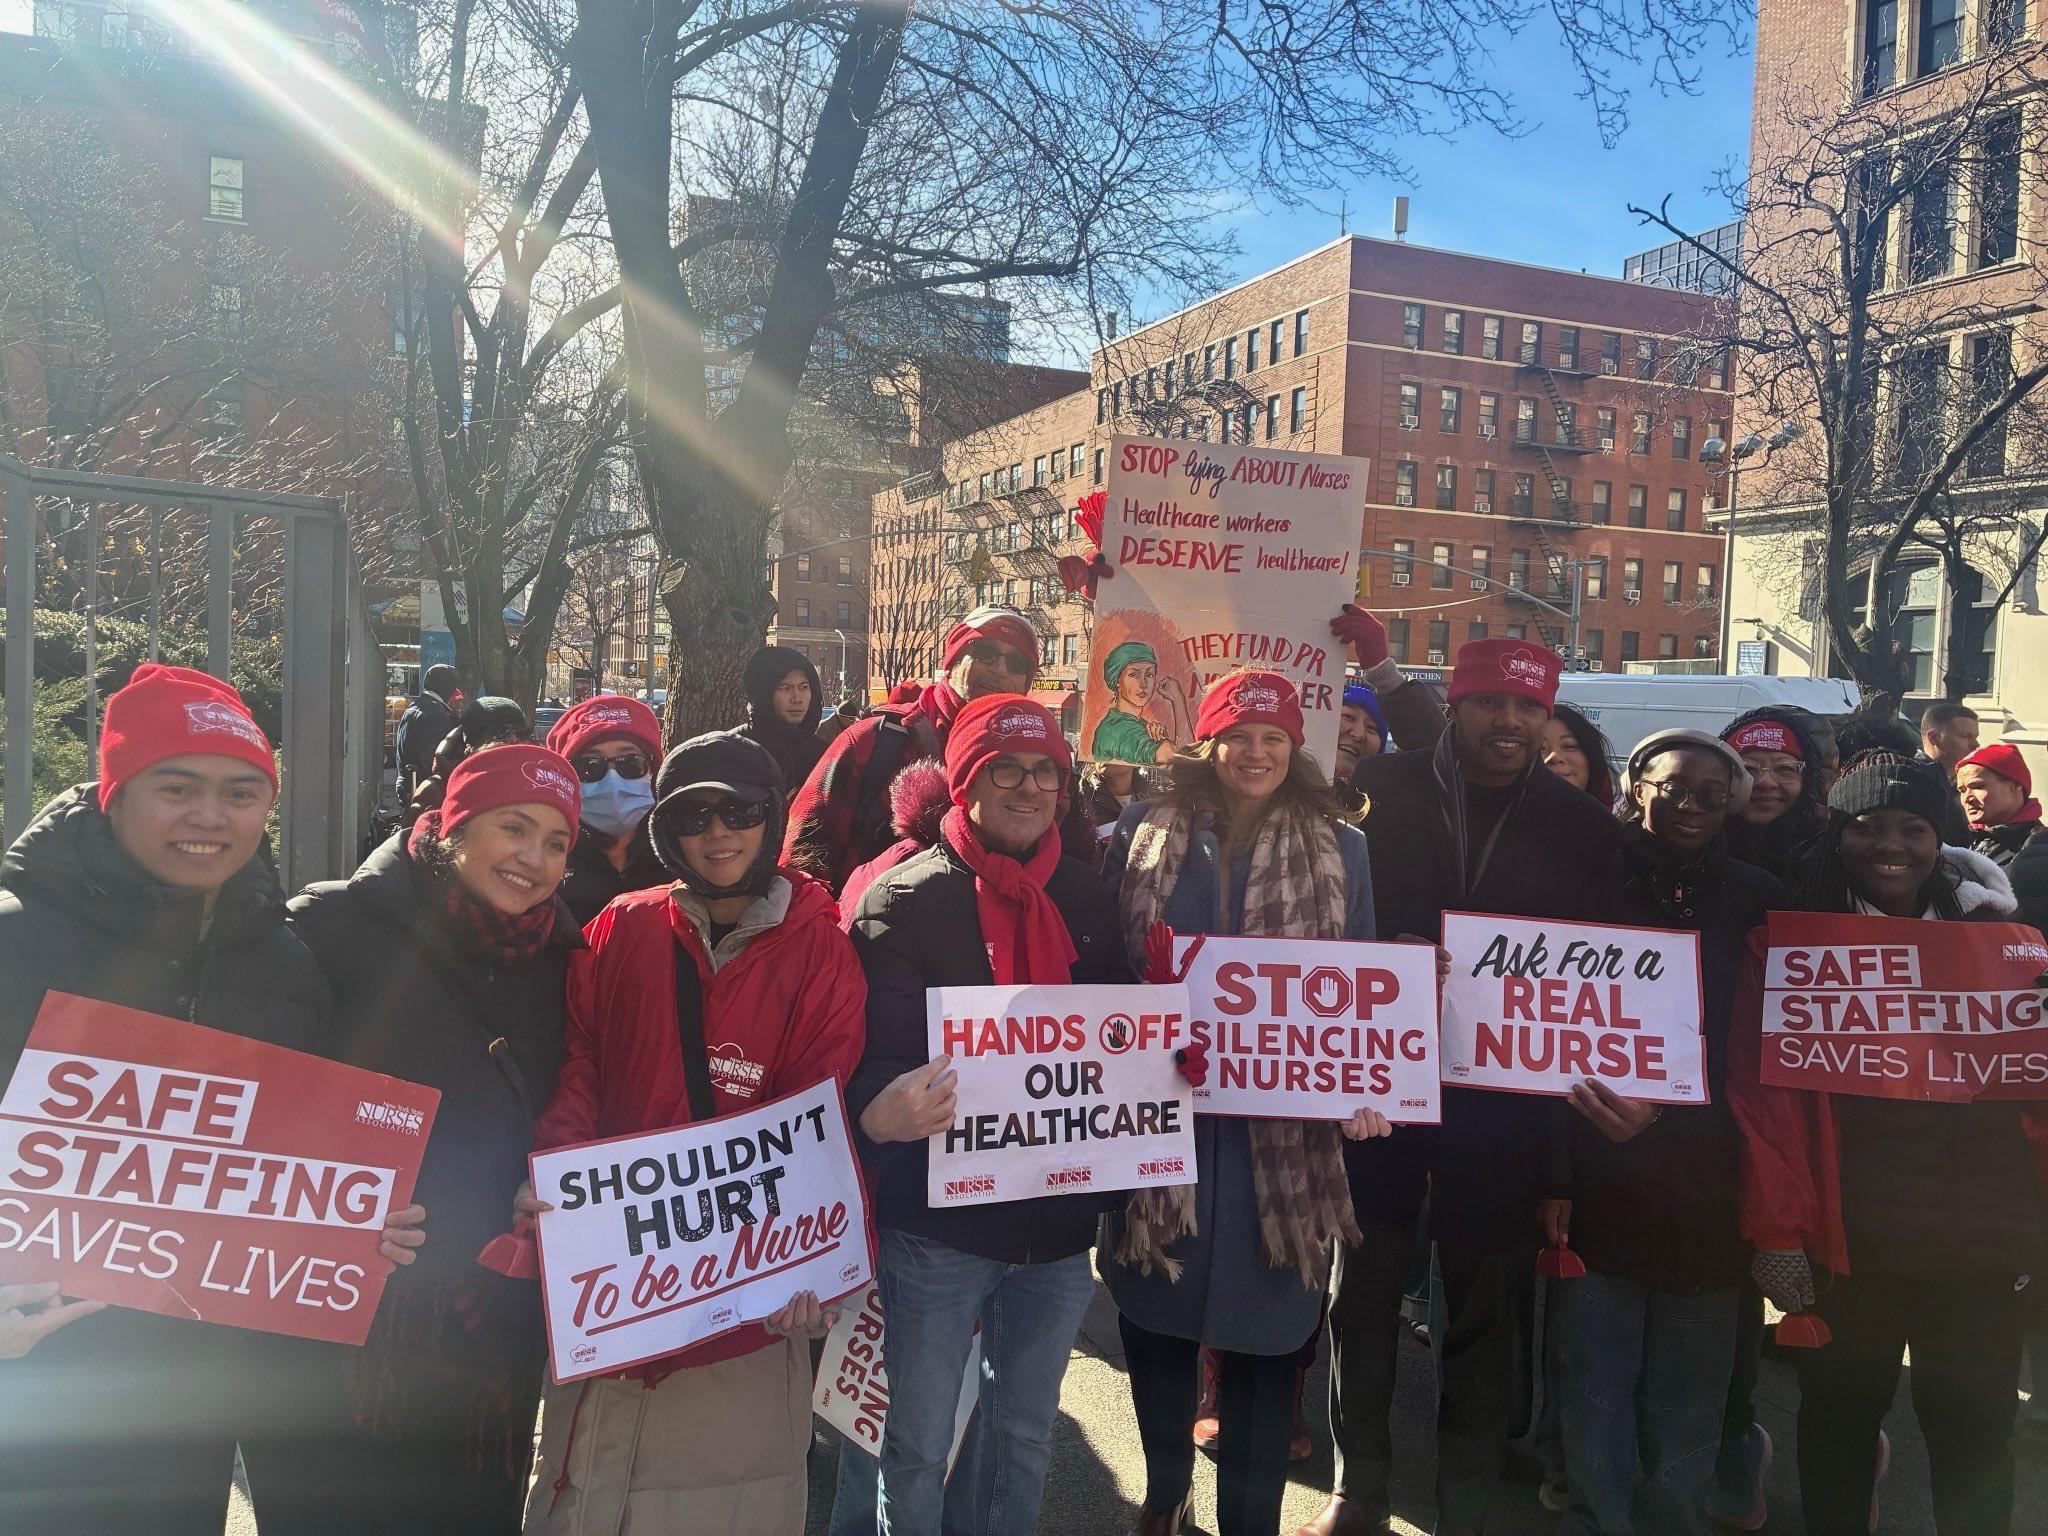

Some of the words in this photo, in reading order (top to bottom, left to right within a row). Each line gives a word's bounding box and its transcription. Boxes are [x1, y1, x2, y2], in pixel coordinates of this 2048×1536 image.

[1120, 444, 1179, 478] STOP
[1182, 449, 1228, 499] lying
[1229, 456, 1300, 487] ABOUT
[1299, 463, 1350, 491] Nurses
[1123, 497, 1220, 530] Healthcare
[1226, 512, 1291, 533] workers
[1119, 535, 1245, 574] DESERVE
[1177, 632, 1232, 663] THEY
[1235, 633, 1294, 663] FUND
[1292, 642, 1327, 677] PR
[1471, 932, 1549, 978] Ask
[1557, 940, 1625, 980] For
[1634, 948, 1664, 981] a
[1784, 948, 1912, 987] SAFE
[1213, 961, 1401, 1020] STOP
[1503, 974, 1641, 1030] REAL
[1781, 992, 2042, 1032] STAFFING
[943, 1014, 1086, 1058] HANDS
[1189, 1020, 1426, 1061] SILENCING
[1474, 1022, 1667, 1081] NURSE
[709, 1056, 764, 1081] NURSES
[1024, 1060, 1104, 1099] OUR
[1219, 1058, 1392, 1095] NURSES
[1779, 1037, 1909, 1079] SAVES
[1928, 1049, 2048, 1084] LIVES
[39, 1060, 245, 1139] SAFE
[357, 1100, 424, 1130] NURSES
[354, 1116, 420, 1136] ASSOCIATION
[946, 1100, 1181, 1154] HEALTHCARE
[8, 1131, 382, 1225] STAFFING
[559, 1104, 826, 1211] SHOULDN'T
[1045, 1170, 1092, 1186] NURSES
[1138, 1160, 1183, 1175] NURSES
[944, 1179, 996, 1196] NURSES
[944, 1190, 997, 1200] ASSOCIATION
[624, 1166, 785, 1257] HURT
[0, 1199, 185, 1280] SAVES
[200, 1240, 366, 1312] LIVES
[571, 1264, 619, 1327] To
[632, 1254, 682, 1309] be
[690, 1254, 723, 1291] a
[726, 1200, 849, 1279] Nurse
[836, 1289, 885, 1401] URSES
